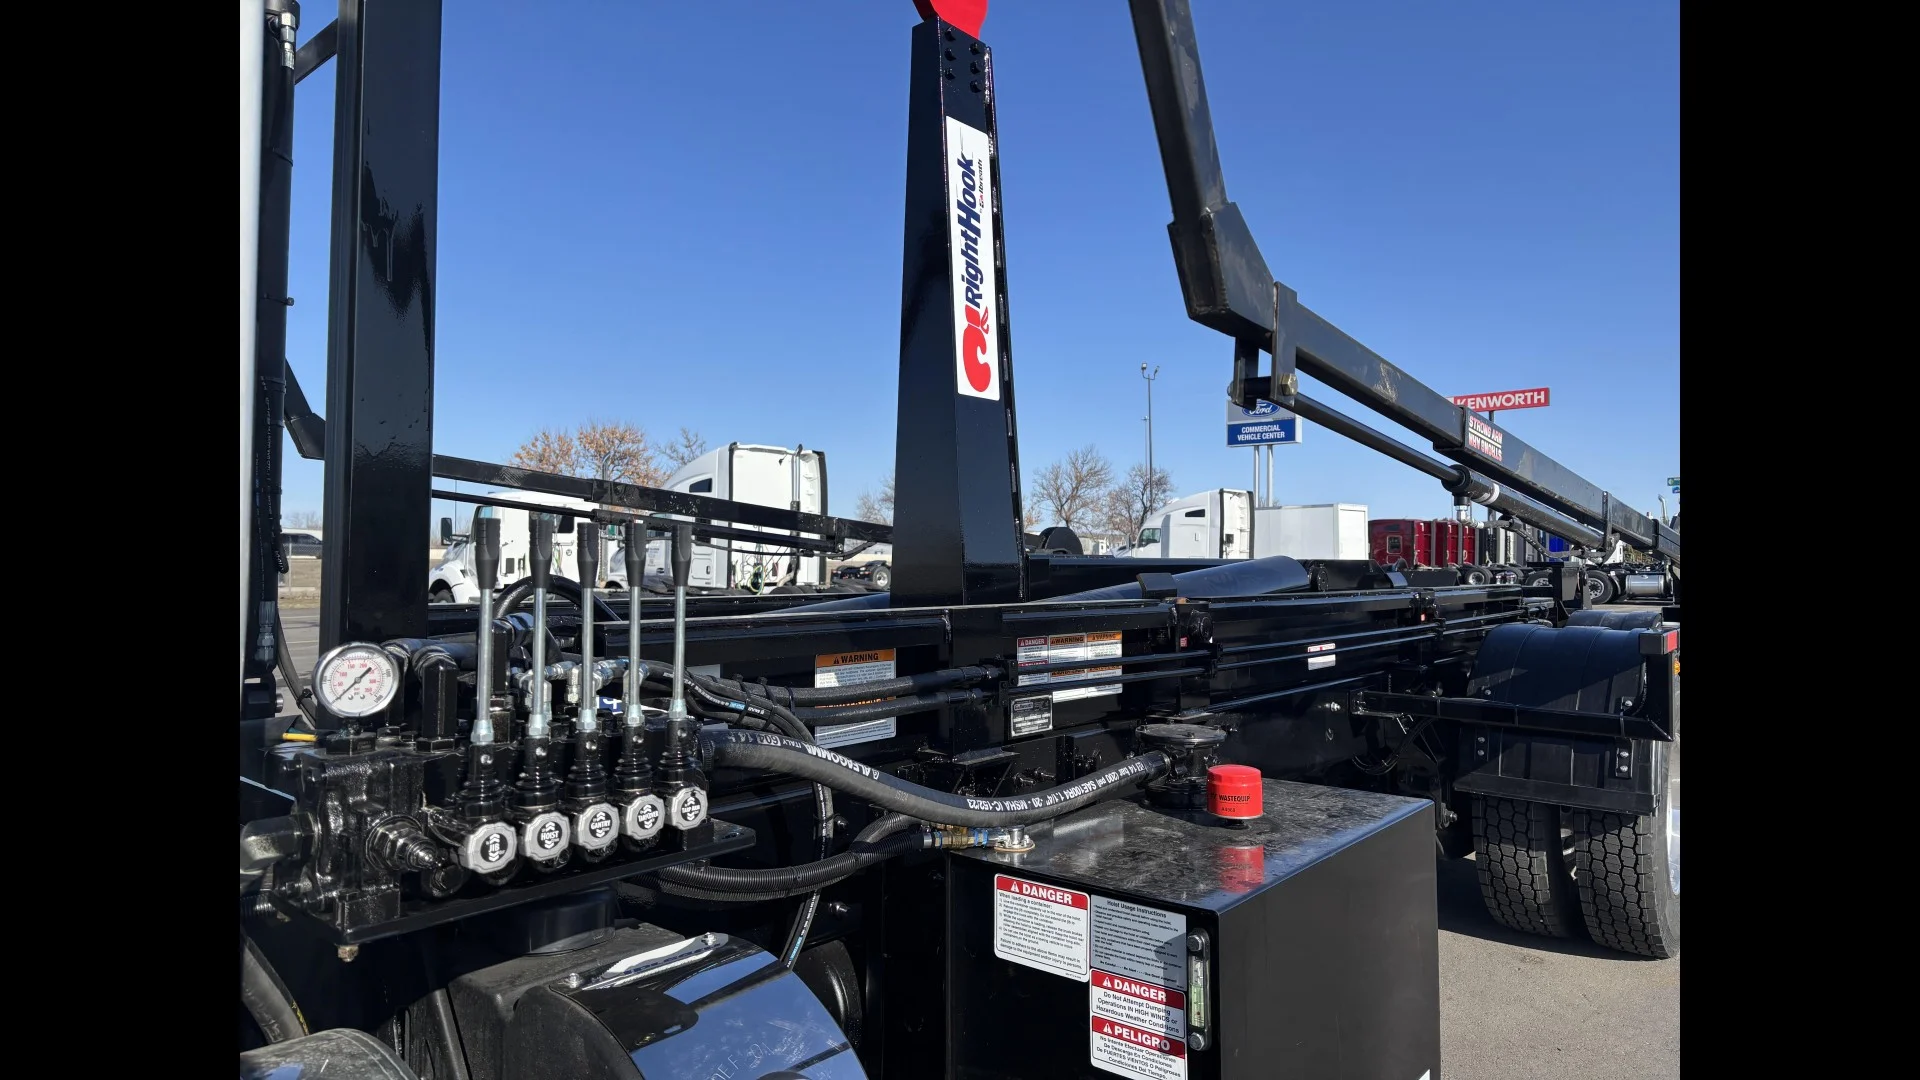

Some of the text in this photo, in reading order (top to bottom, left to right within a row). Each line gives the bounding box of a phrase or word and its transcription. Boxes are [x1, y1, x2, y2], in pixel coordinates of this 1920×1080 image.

[957, 155, 984, 309] RightHook
[1456, 391, 1545, 409] KENWORTH
[1241, 424, 1281, 433] COMMERCIAL
[1469, 415, 1491, 437] STRONG
[1237, 433, 1261, 441] VEHICLE
[1055, 636, 1084, 644] WARNING
[841, 653, 879, 663] WARNING
[782, 738, 802, 749] ITALY
[802, 740, 871, 776] ALFAGOMMA
[1119, 768, 1129, 777] bar
[1006, 799, 1028, 811] MSHA
[1219, 794, 1250, 803] WASTEQUIP
[590, 819, 611, 830] GANTRY
[540, 830, 560, 840] HOIST
[489, 843, 500, 852] JIB
[1022, 885, 1073, 905] DANGER
[1107, 900, 1166, 918] Hoist Usage Instructions
[1114, 978, 1166, 1002] DANGER
[1098, 998, 1127, 1010] Operations
[1134, 1008, 1149, 1016] HIGH
[1150, 1012, 1170, 1023] WINDS
[1112, 993, 1122, 1001] Not
[1123, 996, 1144, 1008] Attempt
[1146, 1003, 1171, 1016] Dumping
[1096, 1004, 1180, 1034] Hazardous Weather Conditions
[1114, 1025, 1170, 1051] PELIGRO
[1104, 1048, 1126, 1061] FUERTES
[1127, 1055, 1149, 1067] VIENTOS
[1108, 1056, 1138, 1070] Condiciones
[1142, 1054, 1173, 1068] Condiciones
[1145, 1049, 1177, 1063] Operaciones
